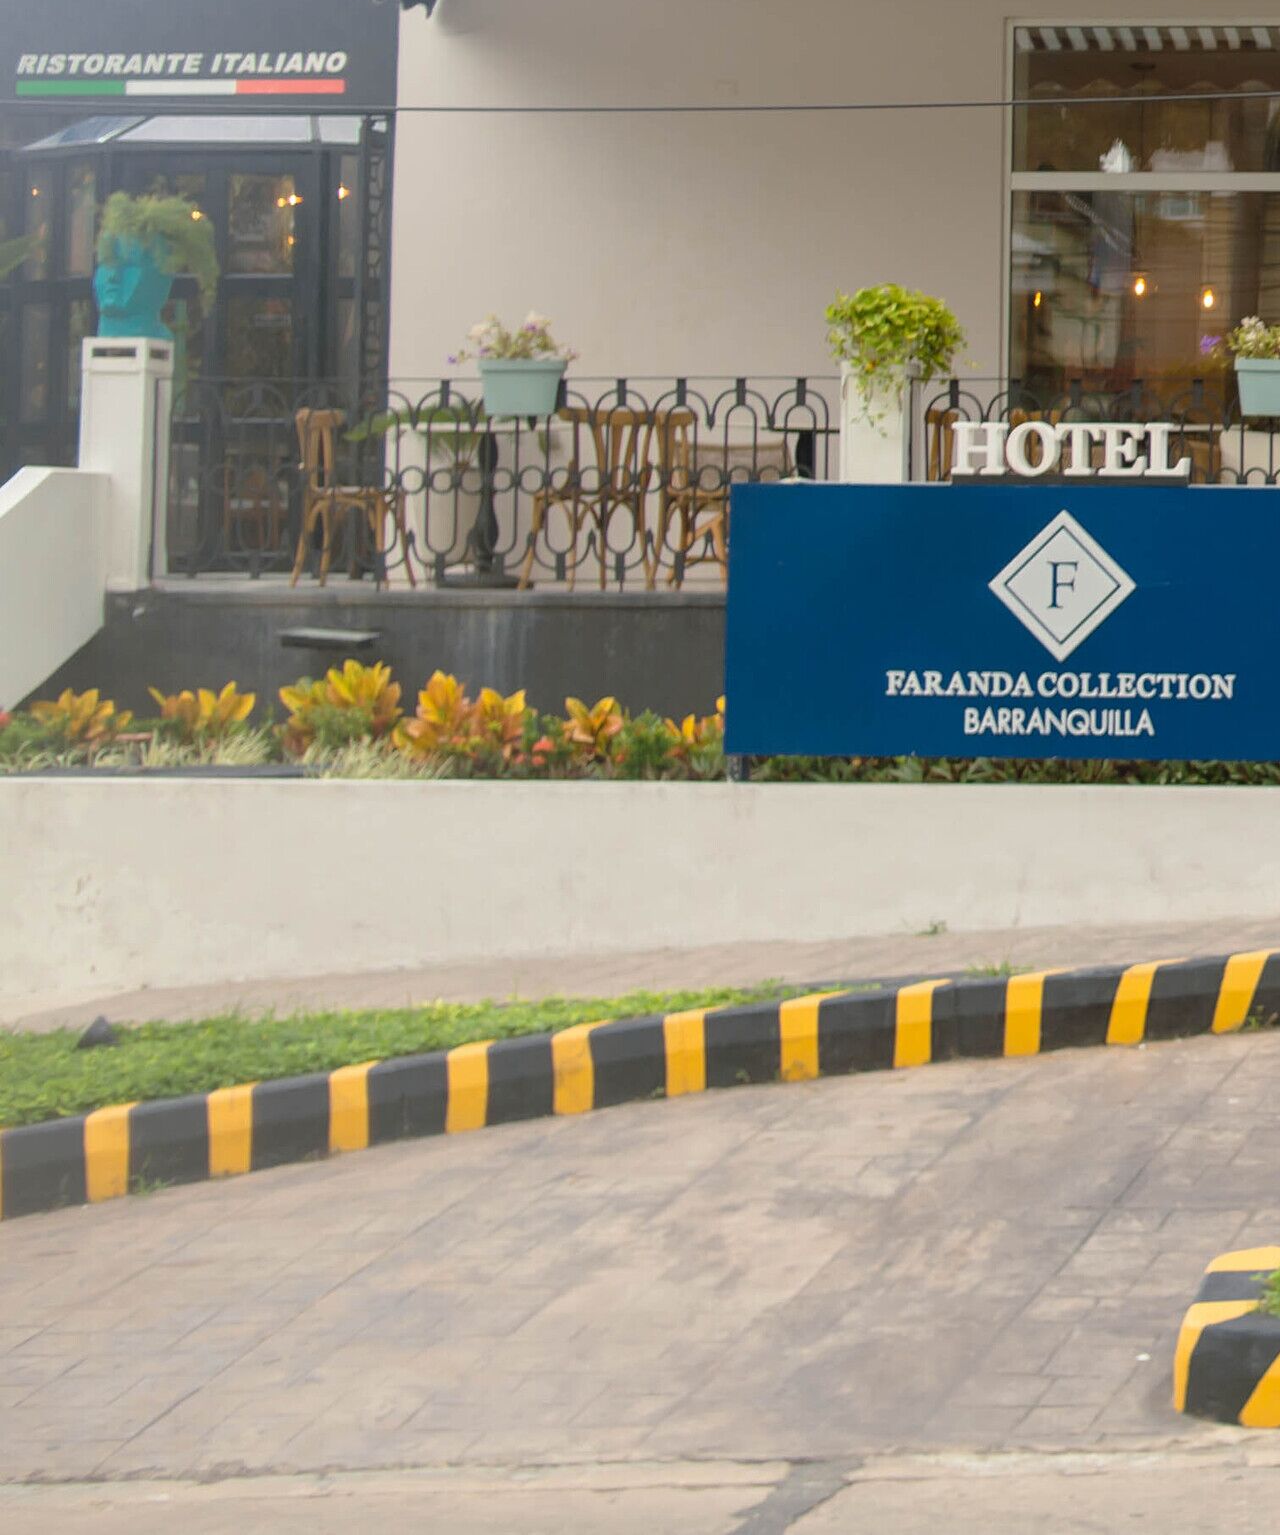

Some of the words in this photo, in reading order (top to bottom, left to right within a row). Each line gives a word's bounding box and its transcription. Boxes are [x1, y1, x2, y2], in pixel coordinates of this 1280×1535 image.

[16, 52, 203, 75] RISTORANTE
[210, 51, 348, 73] ITALIANO
[950, 420, 1192, 477] HOTEL
[1047, 561, 1078, 609] F
[885, 670, 1034, 698] FARANDA
[1037, 672, 1236, 700] COLLECTION
[963, 707, 1155, 737] BARRANQUILLA
